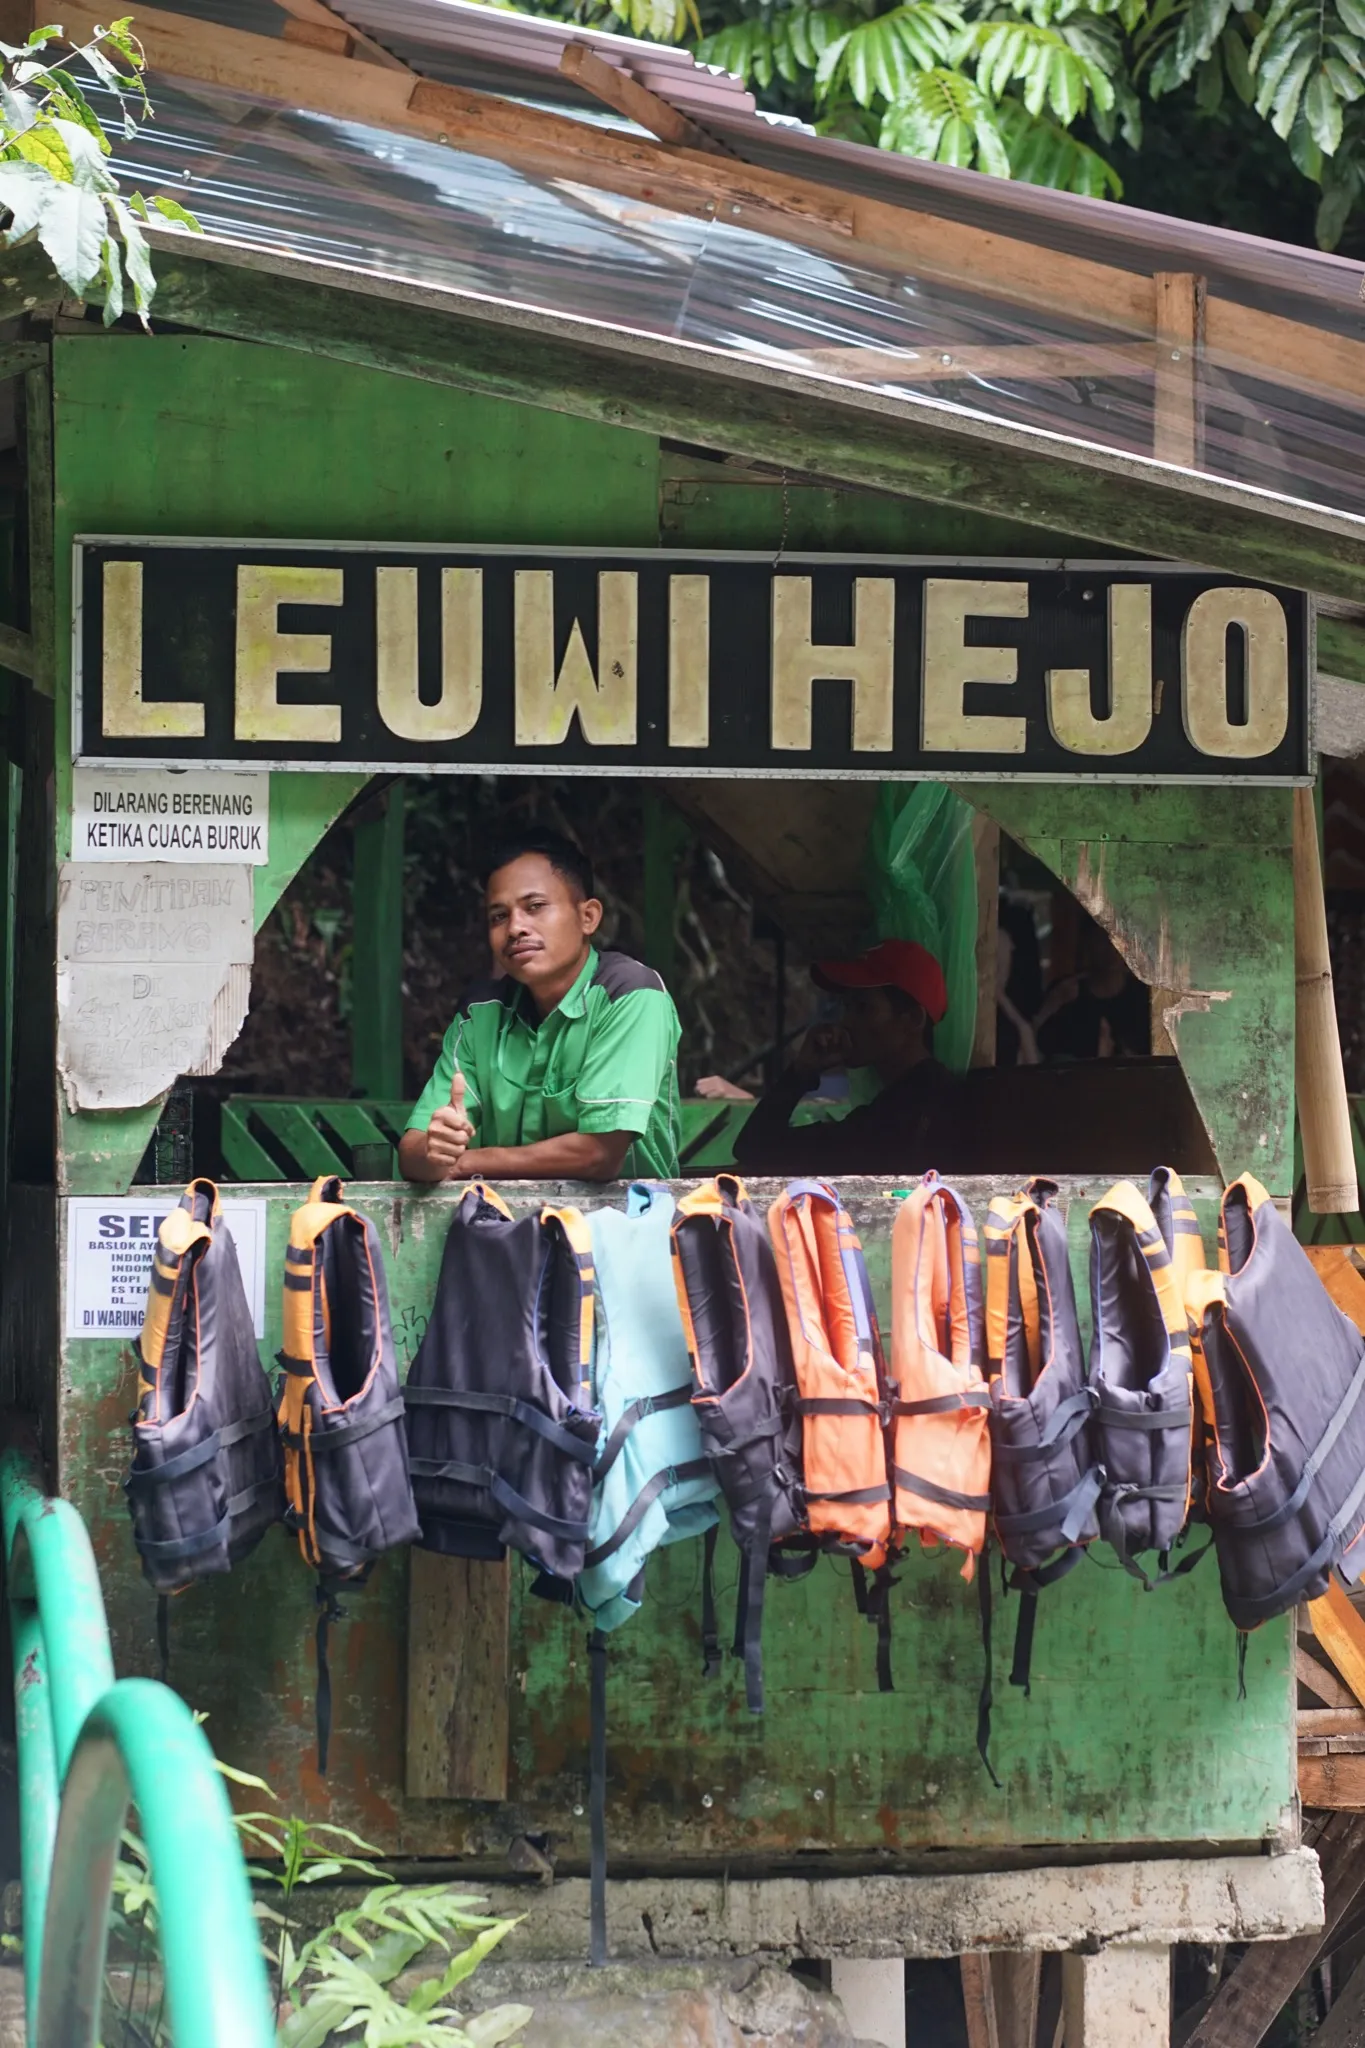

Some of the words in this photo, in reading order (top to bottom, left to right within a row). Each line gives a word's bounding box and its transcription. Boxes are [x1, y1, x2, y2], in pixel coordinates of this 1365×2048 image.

[102, 560, 710, 747] LEUWI
[770, 575, 1289, 758] HEJO
[93, 791, 168, 813] DILARANG
[172, 793, 253, 815] BERENANG
[87, 823, 144, 847] KETIKA
[148, 824, 203, 848] CUACA
[207, 825, 262, 850] BURUK
[111, 1253, 153, 1262] INDOM
[111, 1286, 125, 1294] ES
[83, 1310, 94, 1326] DI
[97, 1310, 145, 1327] WARUNG
